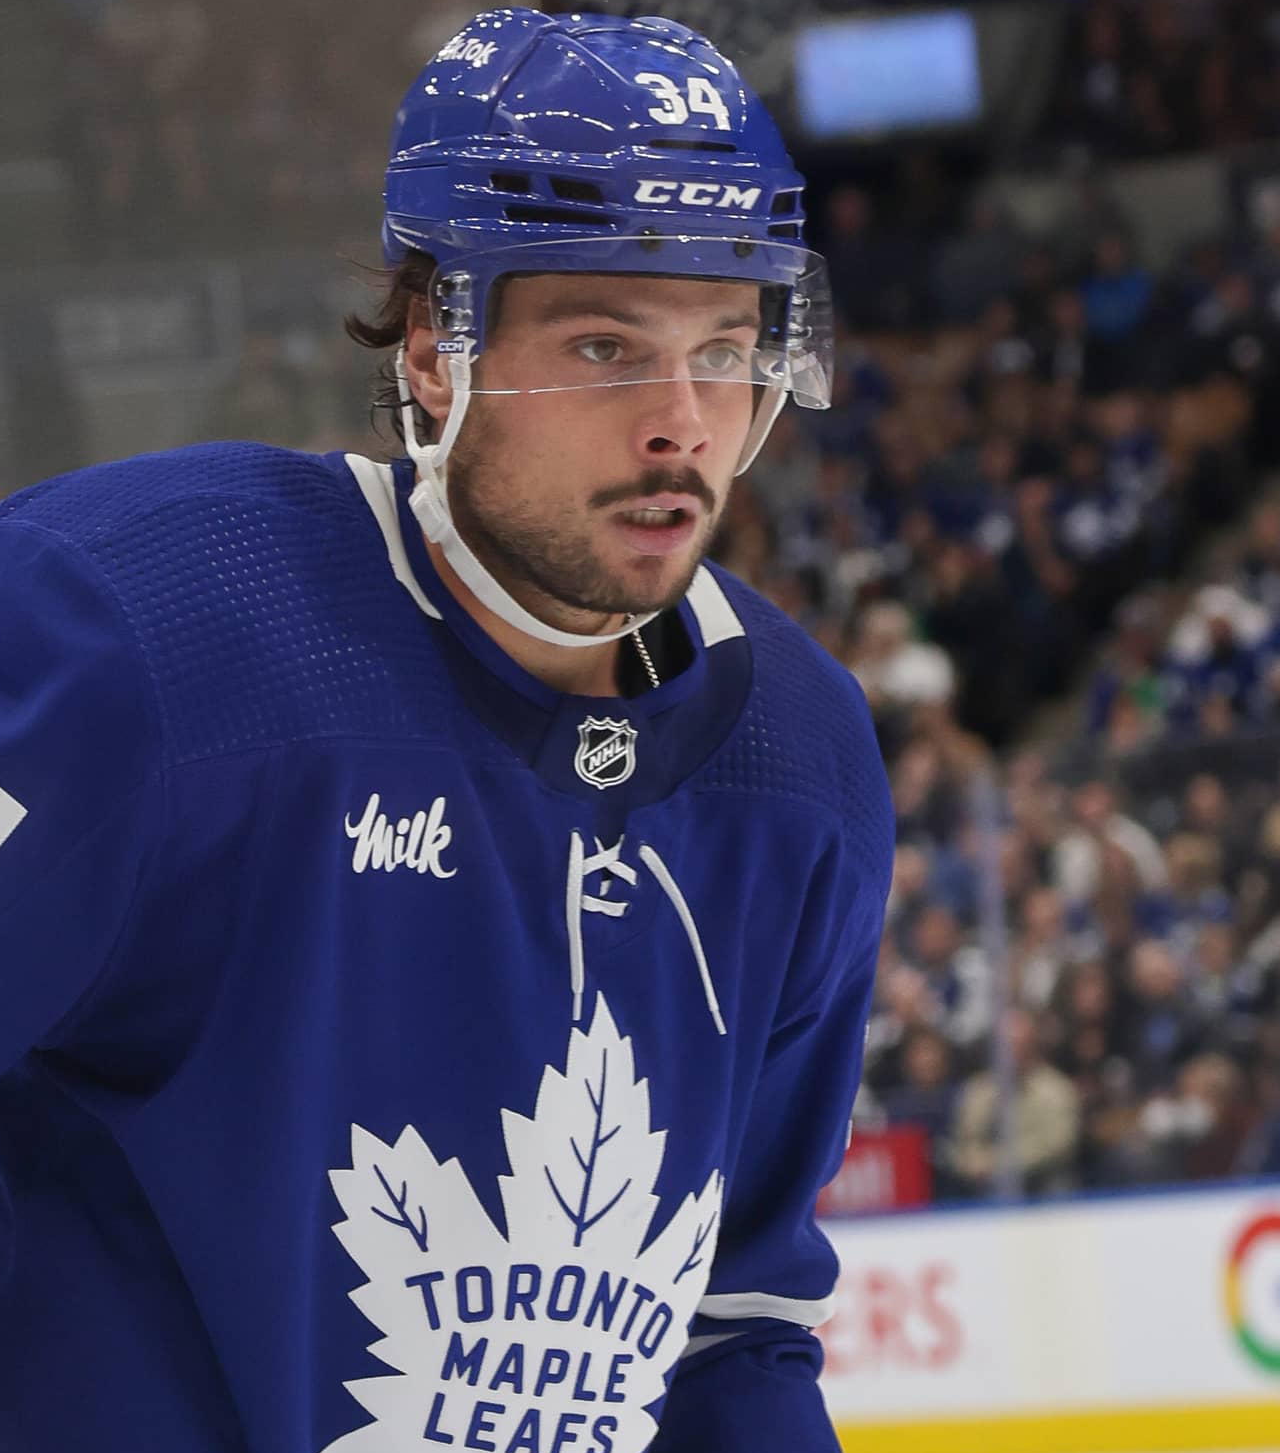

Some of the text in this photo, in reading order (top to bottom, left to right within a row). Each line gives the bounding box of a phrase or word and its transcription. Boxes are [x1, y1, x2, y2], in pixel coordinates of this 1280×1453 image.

[634, 72, 730, 131] 34
[634, 179, 761, 210] CCM
[588, 737, 625, 771] NHL
[405, 1263, 673, 1359] TORONTO
[440, 1332, 634, 1403] MAPLE
